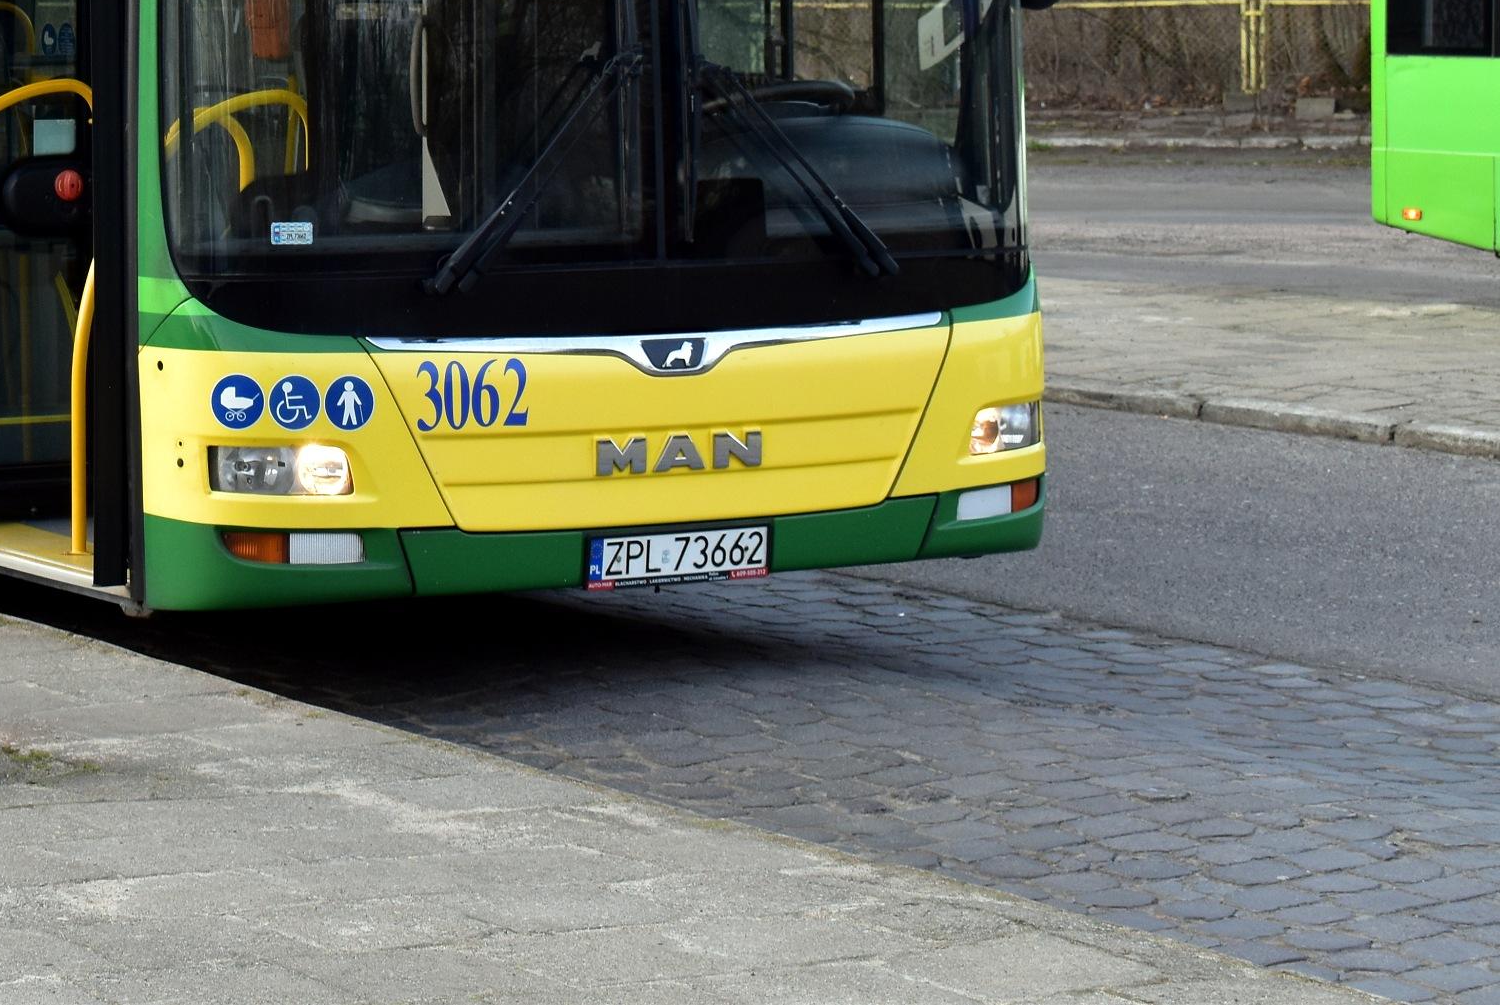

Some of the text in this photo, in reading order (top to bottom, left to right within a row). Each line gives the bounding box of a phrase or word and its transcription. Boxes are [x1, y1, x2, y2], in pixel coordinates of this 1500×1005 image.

[415, 357, 529, 431] 3062
[595, 430, 763, 477] MAN
[590, 565, 600, 576] PL
[605, 531, 763, 576] ZPL 73662
